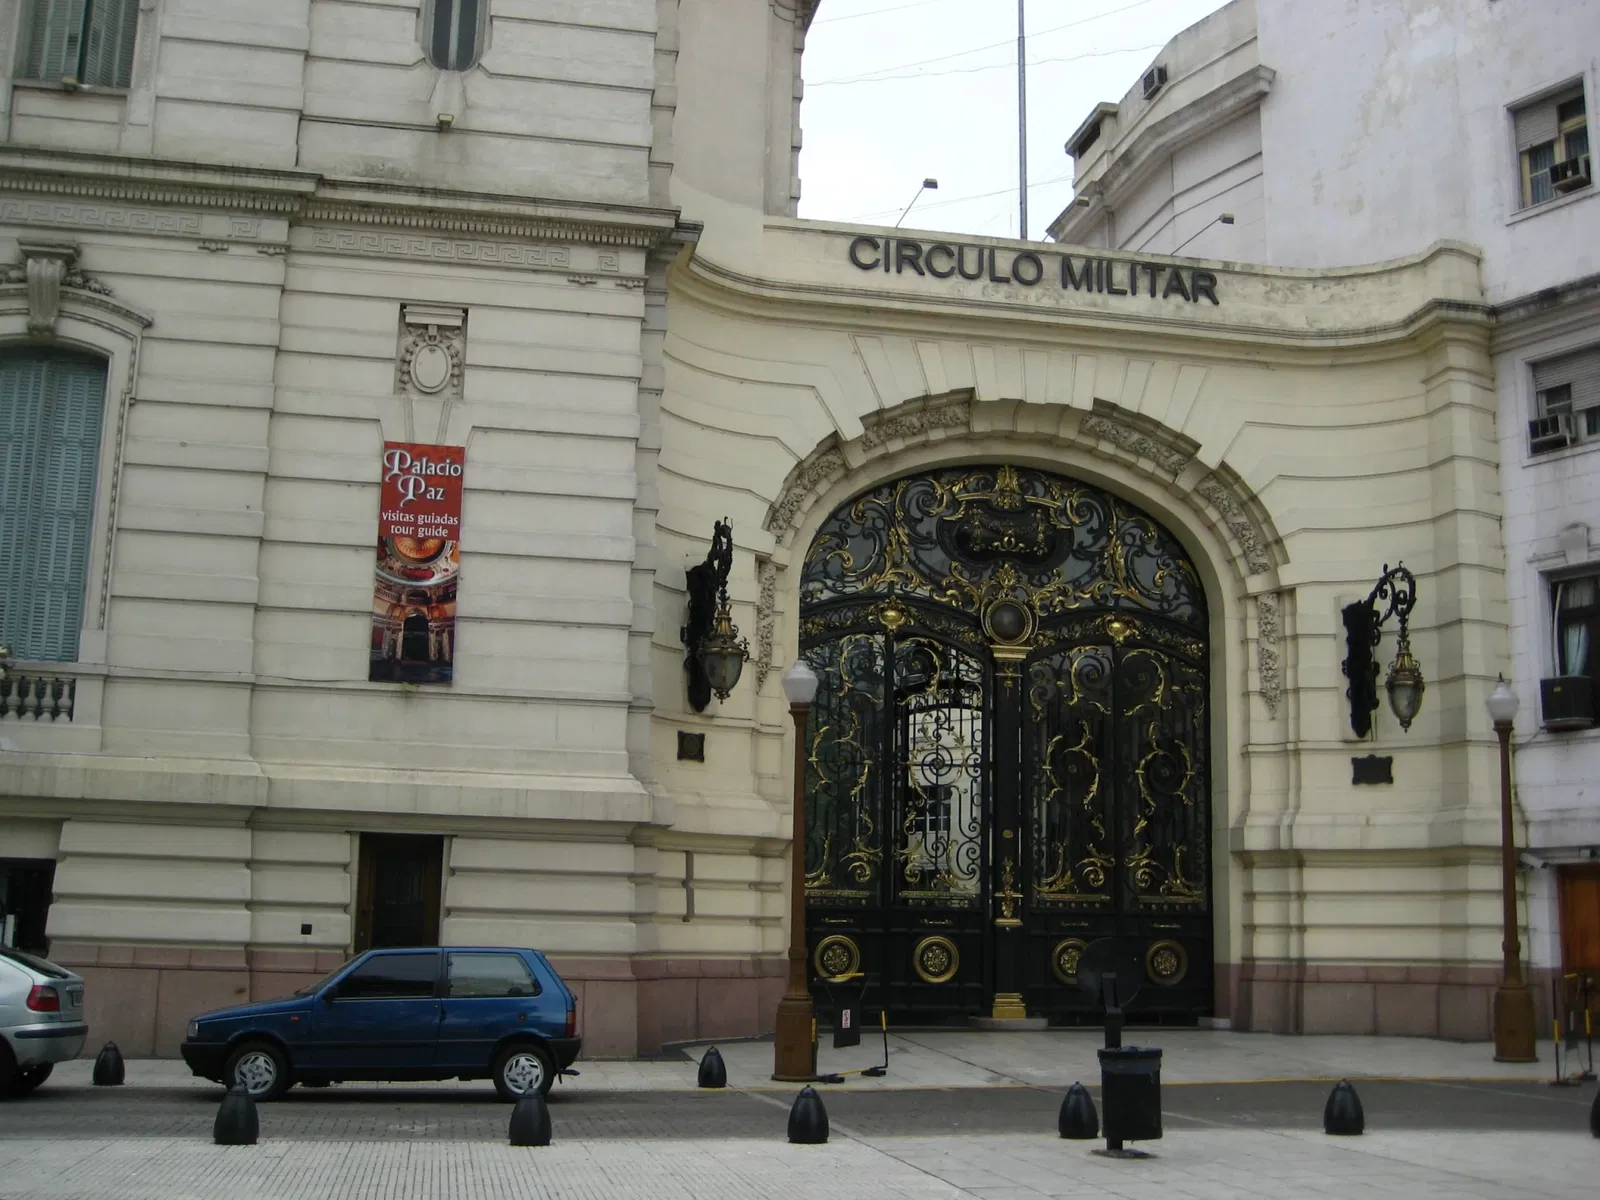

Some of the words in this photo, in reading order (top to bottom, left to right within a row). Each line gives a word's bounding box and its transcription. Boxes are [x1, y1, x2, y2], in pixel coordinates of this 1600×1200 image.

[850, 236, 1043, 286] CIRCULO
[1061, 255, 1219, 305] MILITAR
[384, 449, 462, 482] Palacio
[398, 475, 445, 508] Paz
[382, 510, 414, 522] visitas
[417, 513, 458, 525] guiadas
[391, 525, 414, 535] tour
[418, 525, 448, 537] guide
